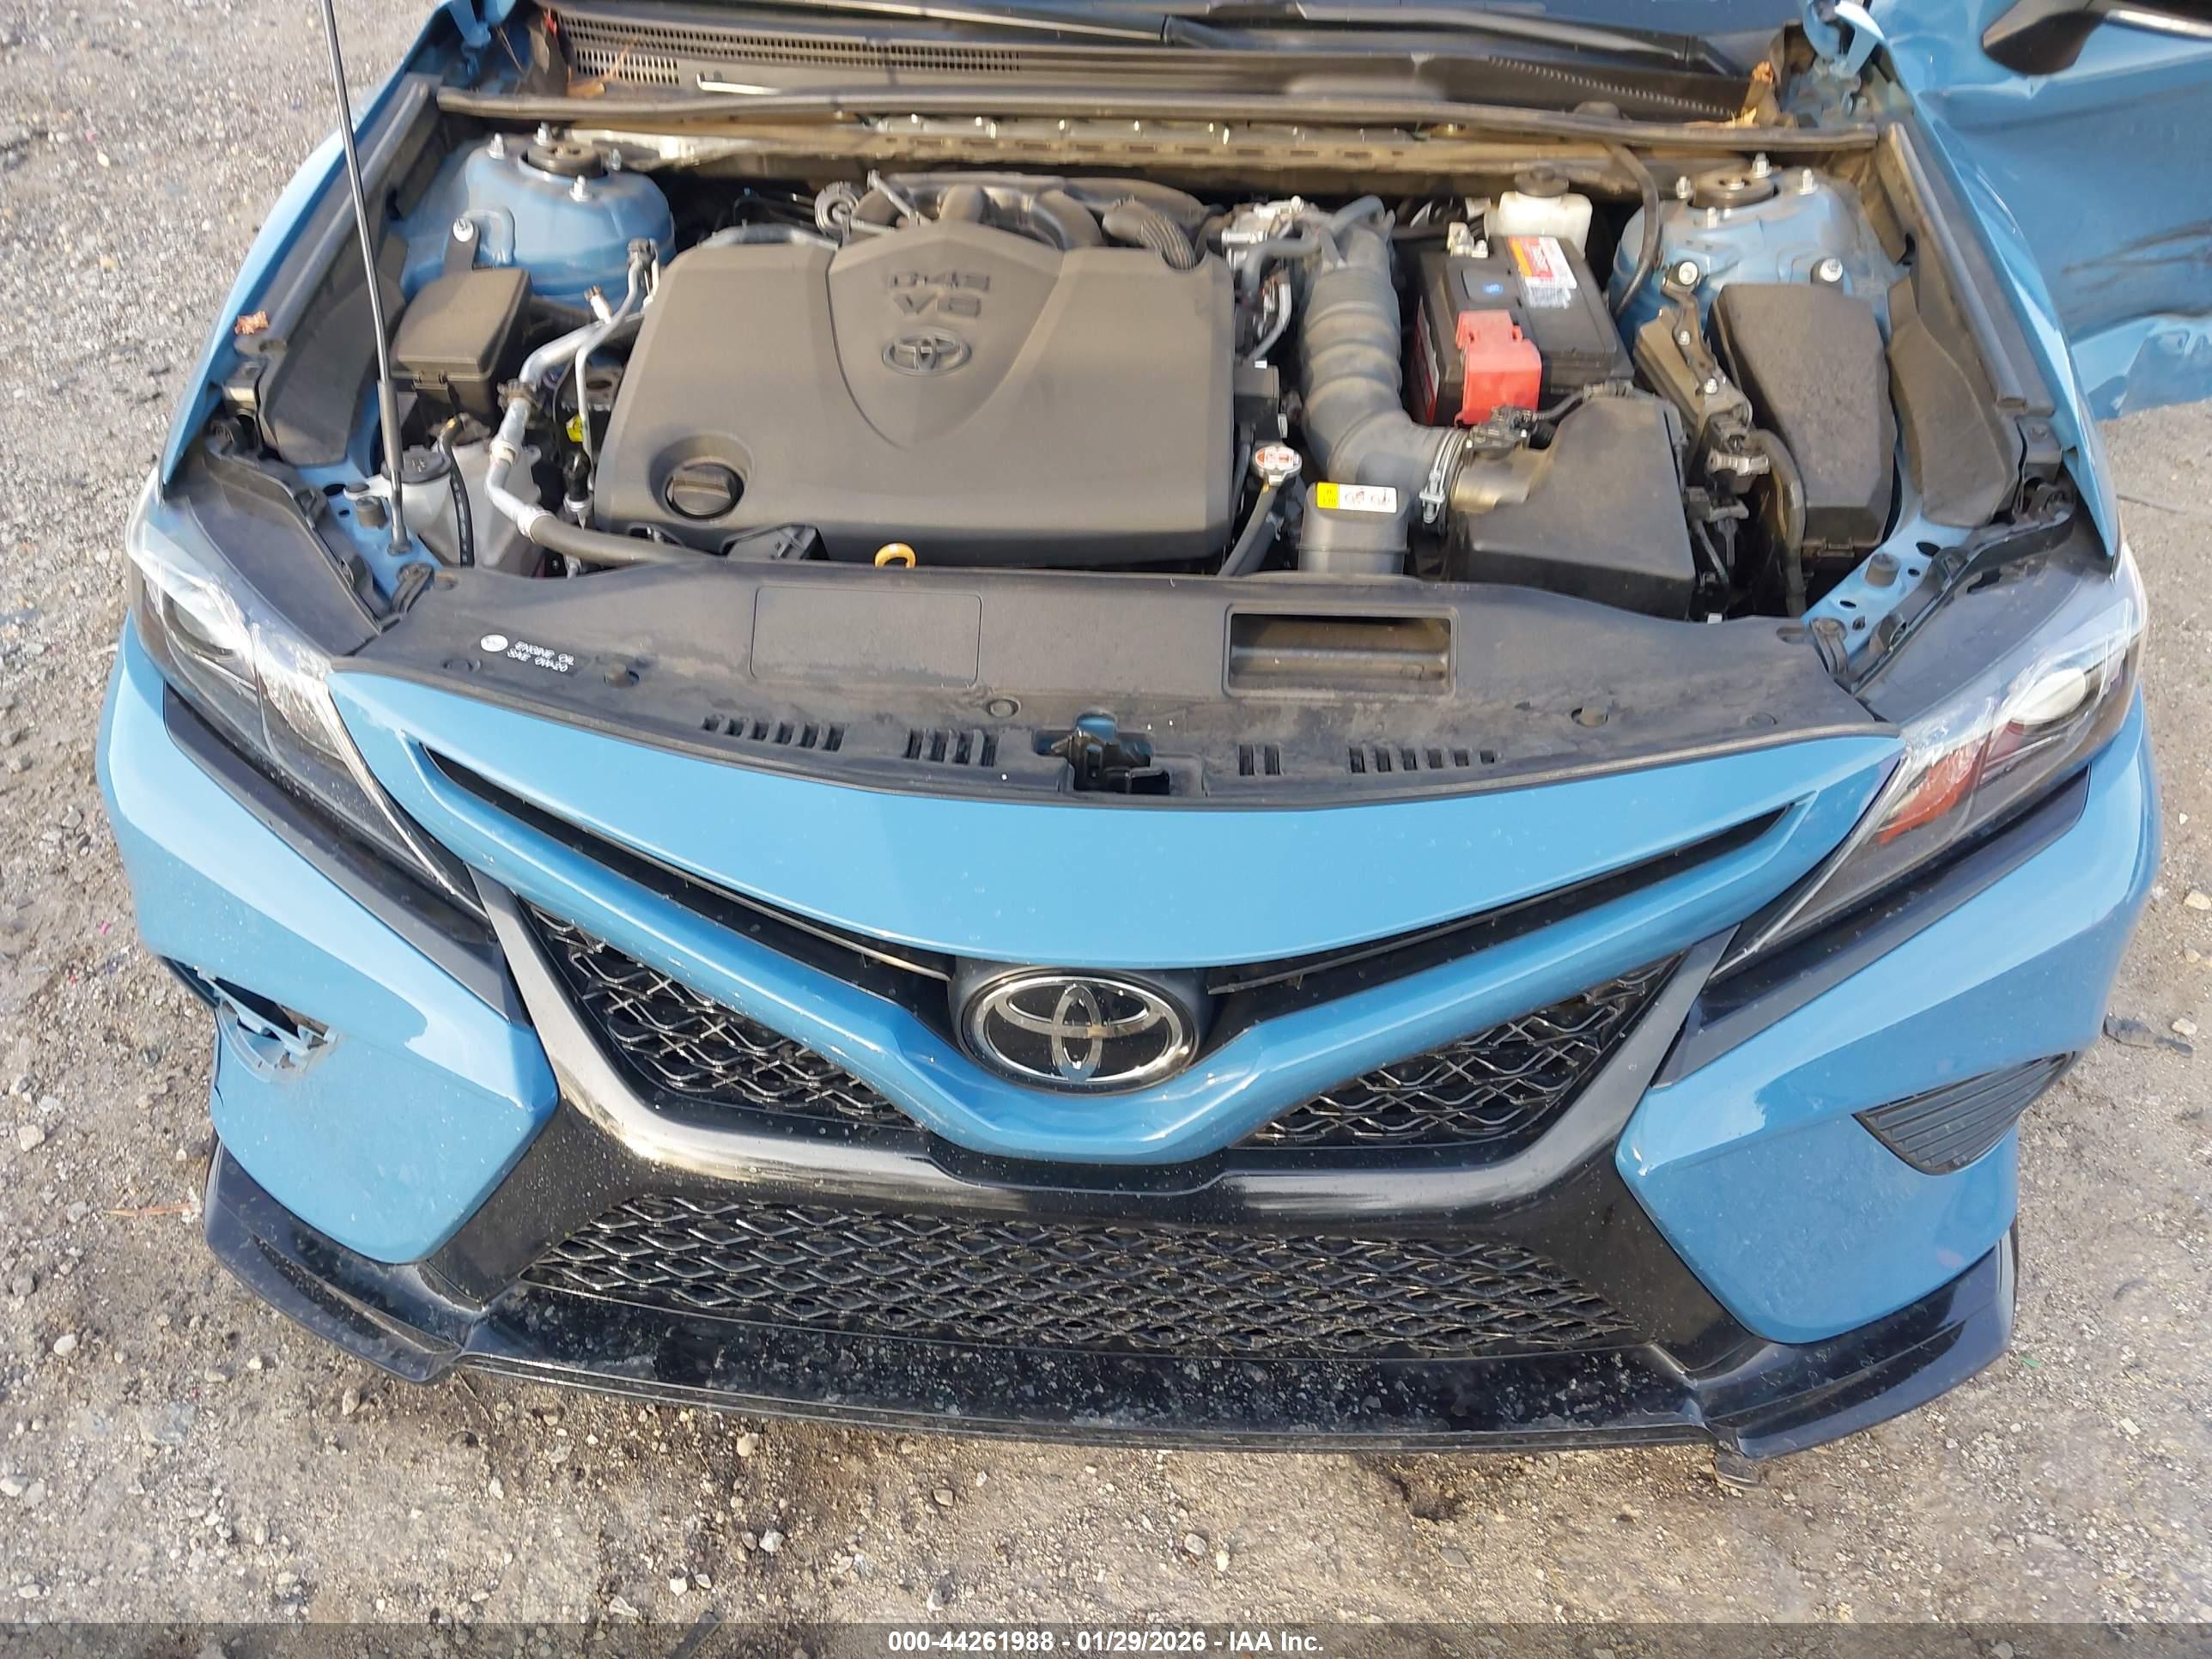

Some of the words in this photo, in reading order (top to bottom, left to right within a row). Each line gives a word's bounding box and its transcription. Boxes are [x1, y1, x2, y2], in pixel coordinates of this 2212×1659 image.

[893, 293, 981, 318] V6
[507, 647, 532, 662] SAE
[515, 641, 555, 659] ENGINE
